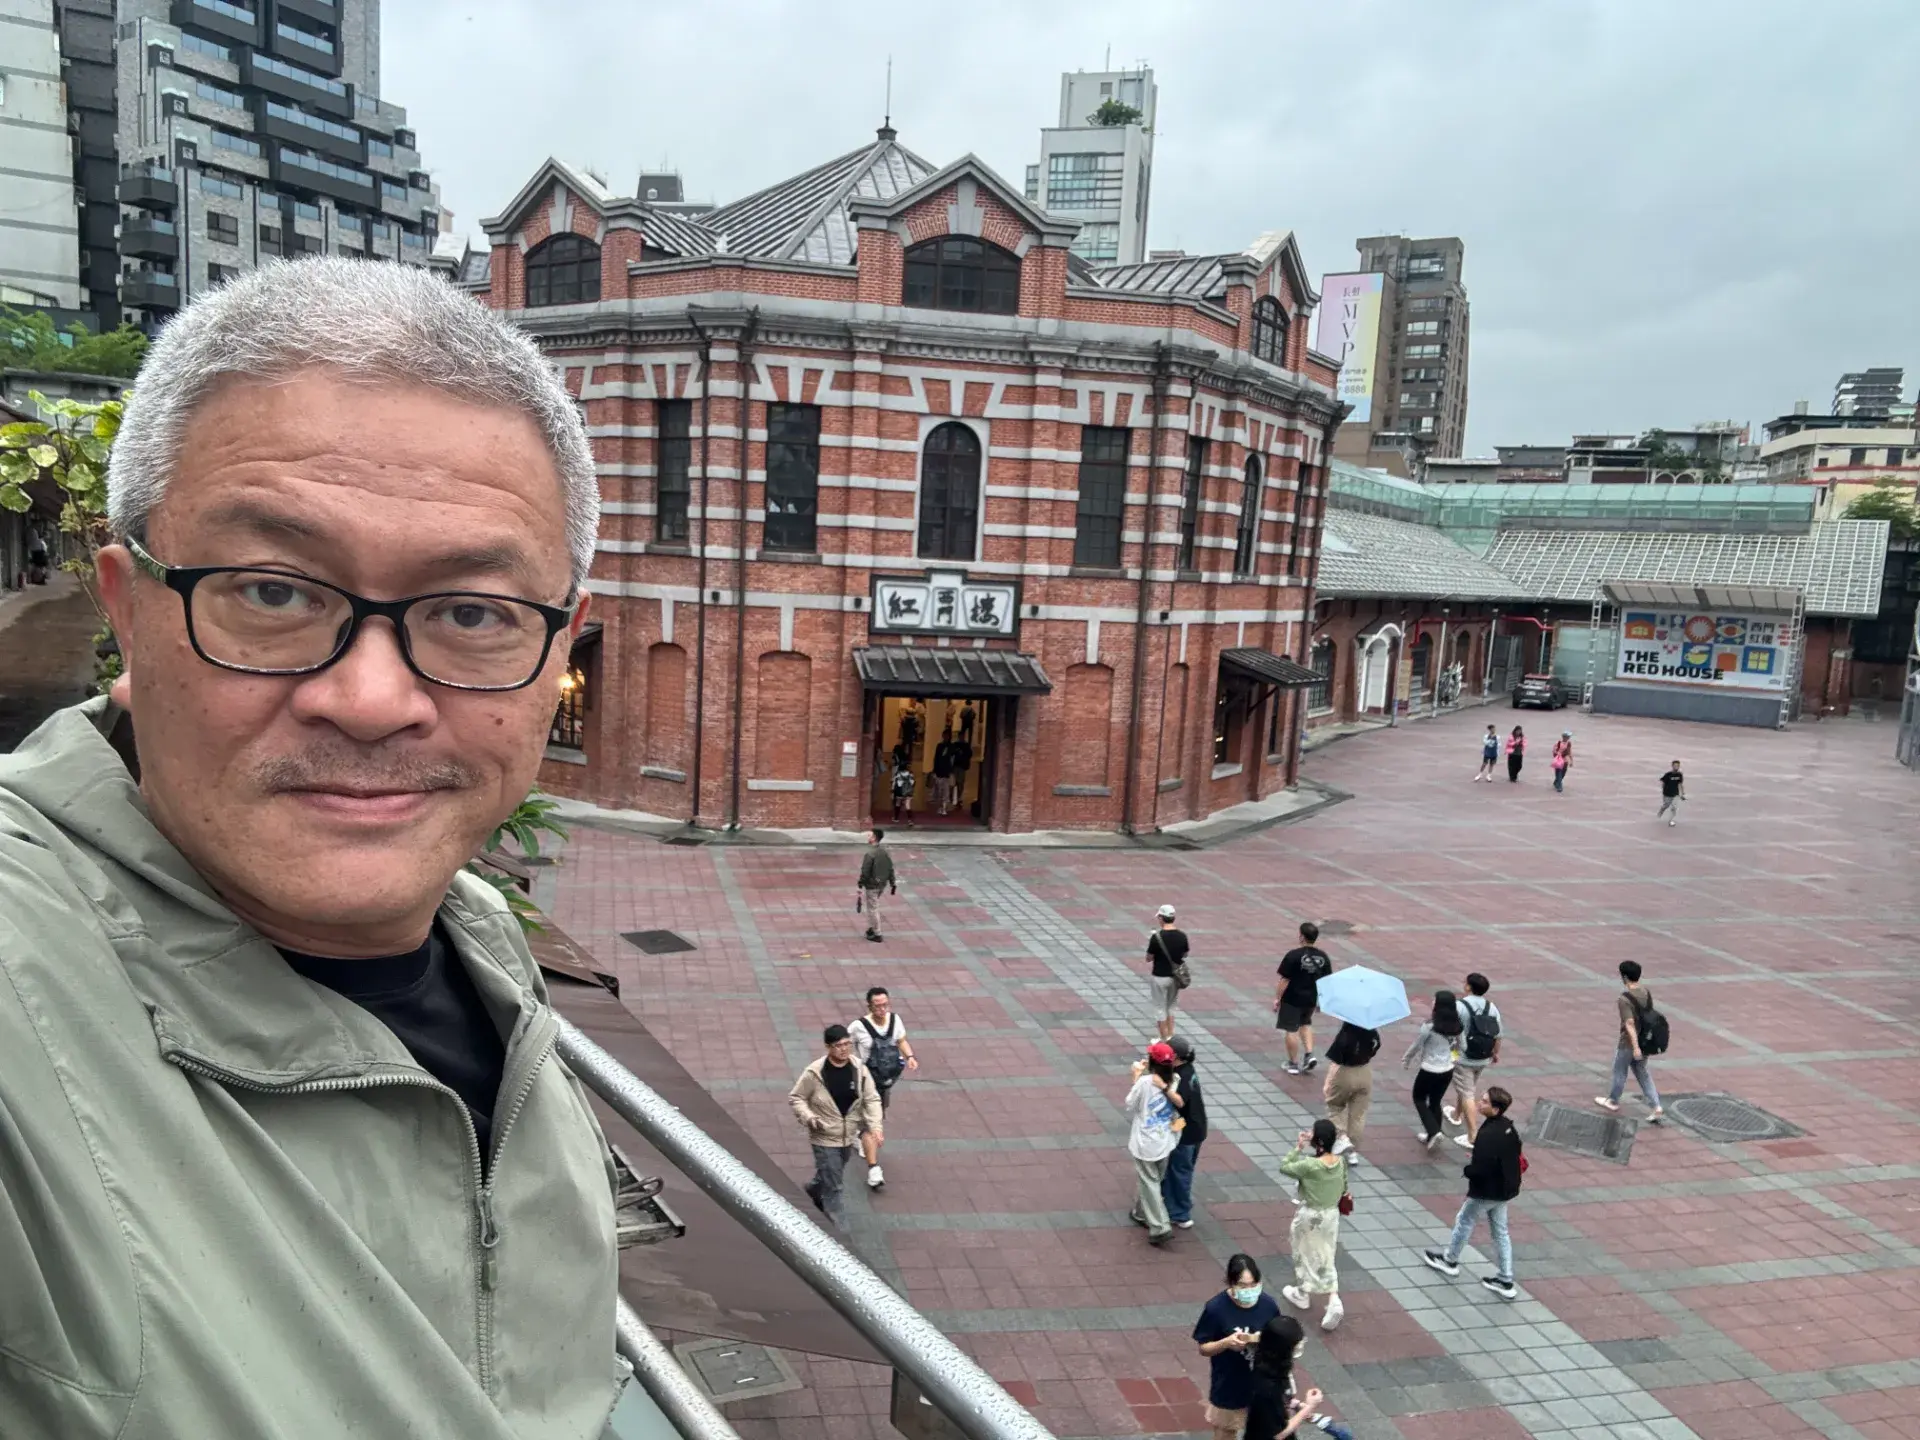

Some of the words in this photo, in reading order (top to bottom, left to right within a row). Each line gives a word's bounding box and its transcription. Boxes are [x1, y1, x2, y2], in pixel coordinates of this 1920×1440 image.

[1341, 303, 1358, 361] MVP
[888, 590, 920, 620] 紅
[936, 589, 955, 625] 西門
[1624, 650, 1660, 664] THE
[1623, 662, 1659, 675] RED
[1661, 665, 1725, 681] HOUSE
